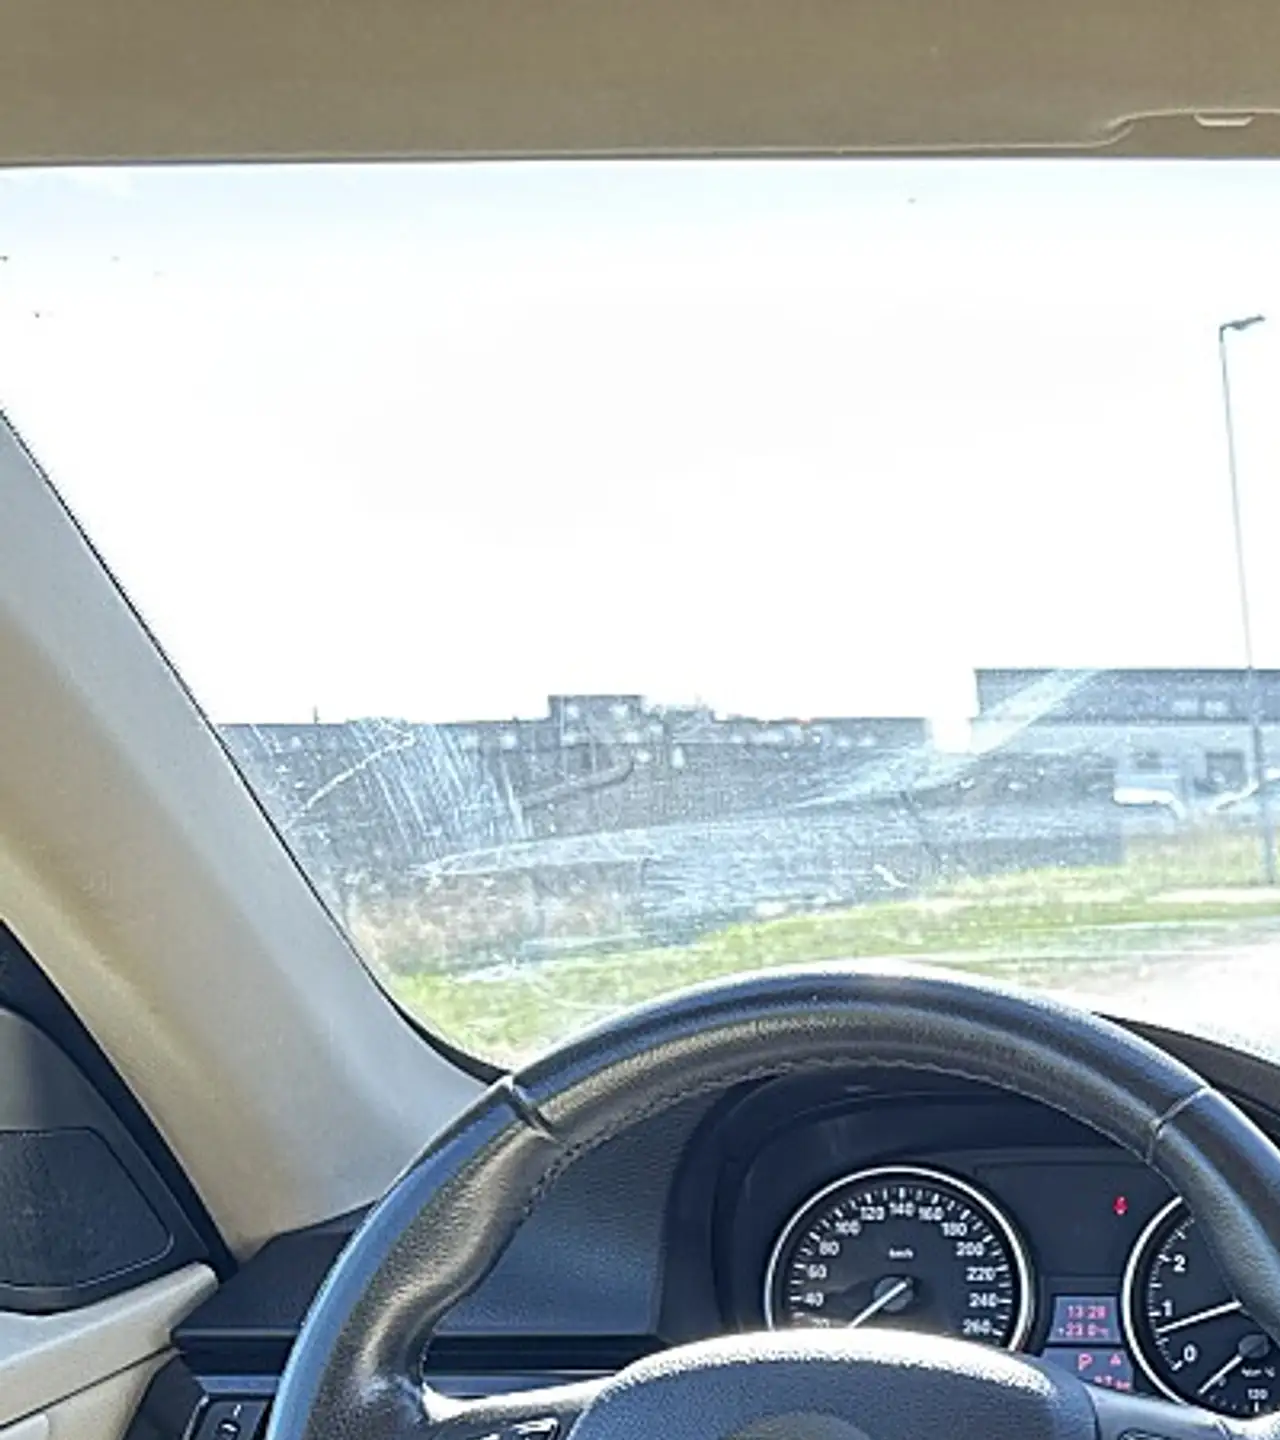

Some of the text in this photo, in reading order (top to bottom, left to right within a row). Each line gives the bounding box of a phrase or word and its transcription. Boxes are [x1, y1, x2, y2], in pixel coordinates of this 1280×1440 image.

[860, 1206, 885, 1220] 120
[889, 1202, 915, 1216] 140
[918, 1206, 943, 1221] 160
[835, 1219, 861, 1235] 100
[941, 1222, 967, 1237] 180
[819, 1241, 839, 1255] 80
[956, 1242, 984, 1257] 200
[1173, 1254, 1186, 1272] 2
[807, 1264, 827, 1279] 60
[966, 1267, 995, 1281] 220
[805, 1292, 824, 1306] 40
[969, 1293, 997, 1307] 240
[1162, 1300, 1172, 1317] 1
[963, 1319, 992, 1333] 260
[1184, 1345, 1197, 1362] 0
[1078, 1353, 1092, 1371] P
